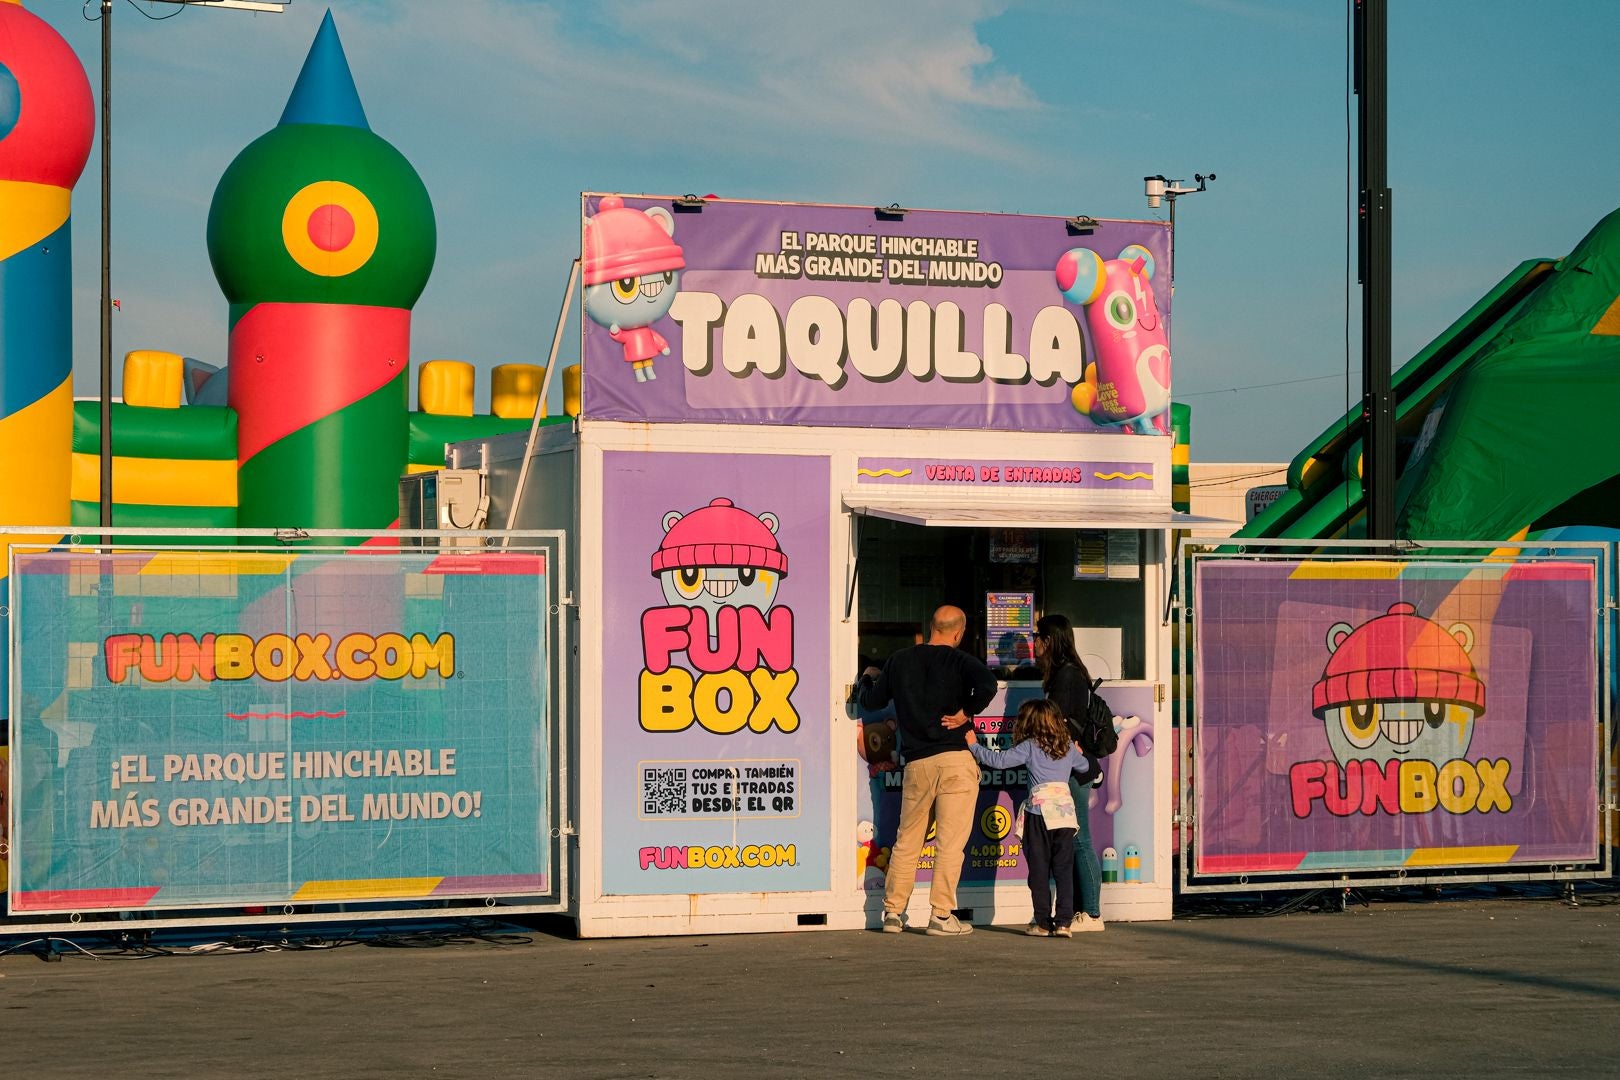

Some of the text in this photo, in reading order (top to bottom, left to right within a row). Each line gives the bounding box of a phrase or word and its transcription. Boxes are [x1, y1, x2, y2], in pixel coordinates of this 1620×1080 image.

[781, 231, 978, 258] EL PARQUE HINCHABLE
[755, 251, 1003, 286] MÁS GRANDE DEL MUNDO
[669, 290, 1087, 390] TAQUILLA
[925, 465, 1082, 483] VENTA DE ENTRADAS
[641, 604, 794, 675] FUN
[638, 665, 801, 735] BOX
[990, 721, 1003, 731] 99
[991, 737, 1006, 747] NO
[111, 748, 457, 790] ¡EL PARQUE HINCHABLE
[744, 764, 794, 779] TAMBIÉN
[1005, 769, 1028, 785] DE
[692, 782, 718, 795] TUS
[1289, 756, 1514, 819] FUNBOX
[90, 790, 482, 828] MÁS GRANDE DEL MUNDO!
[692, 796, 794, 813] DESDE EL QR
[970, 845, 1005, 857] 4.000
[985, 859, 1017, 868] ESPACIO
